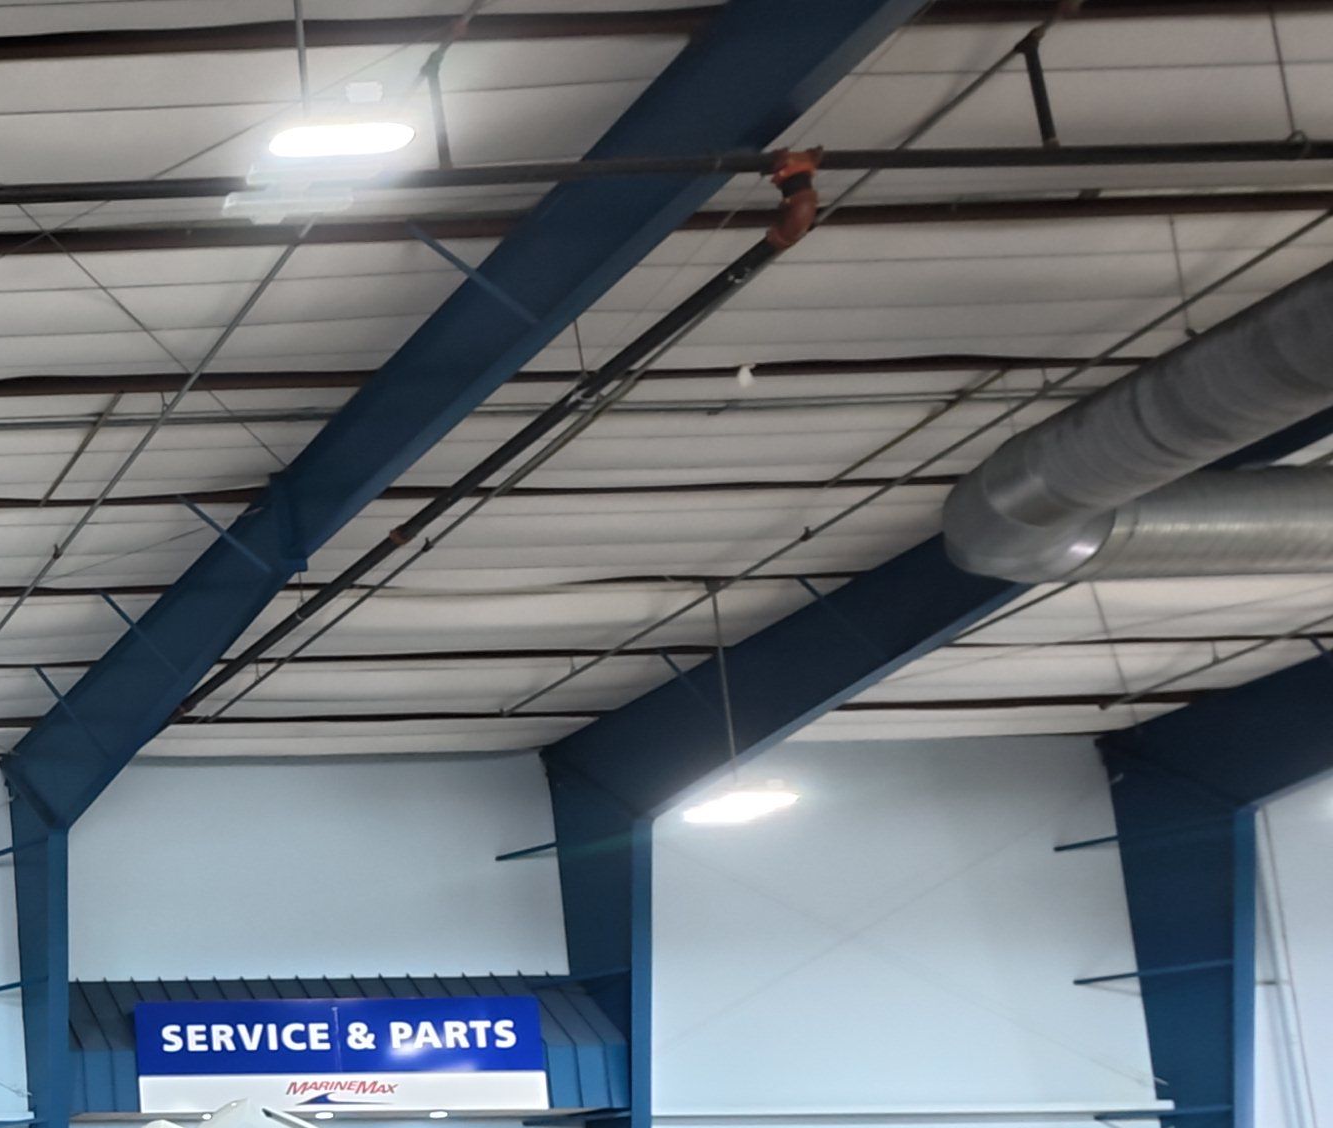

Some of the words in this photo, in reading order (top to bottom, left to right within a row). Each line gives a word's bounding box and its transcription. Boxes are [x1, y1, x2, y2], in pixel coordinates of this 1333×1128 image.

[161, 1023, 331, 1052] SERVICE
[346, 1022, 376, 1050] &
[389, 1019, 517, 1050] PARTS
